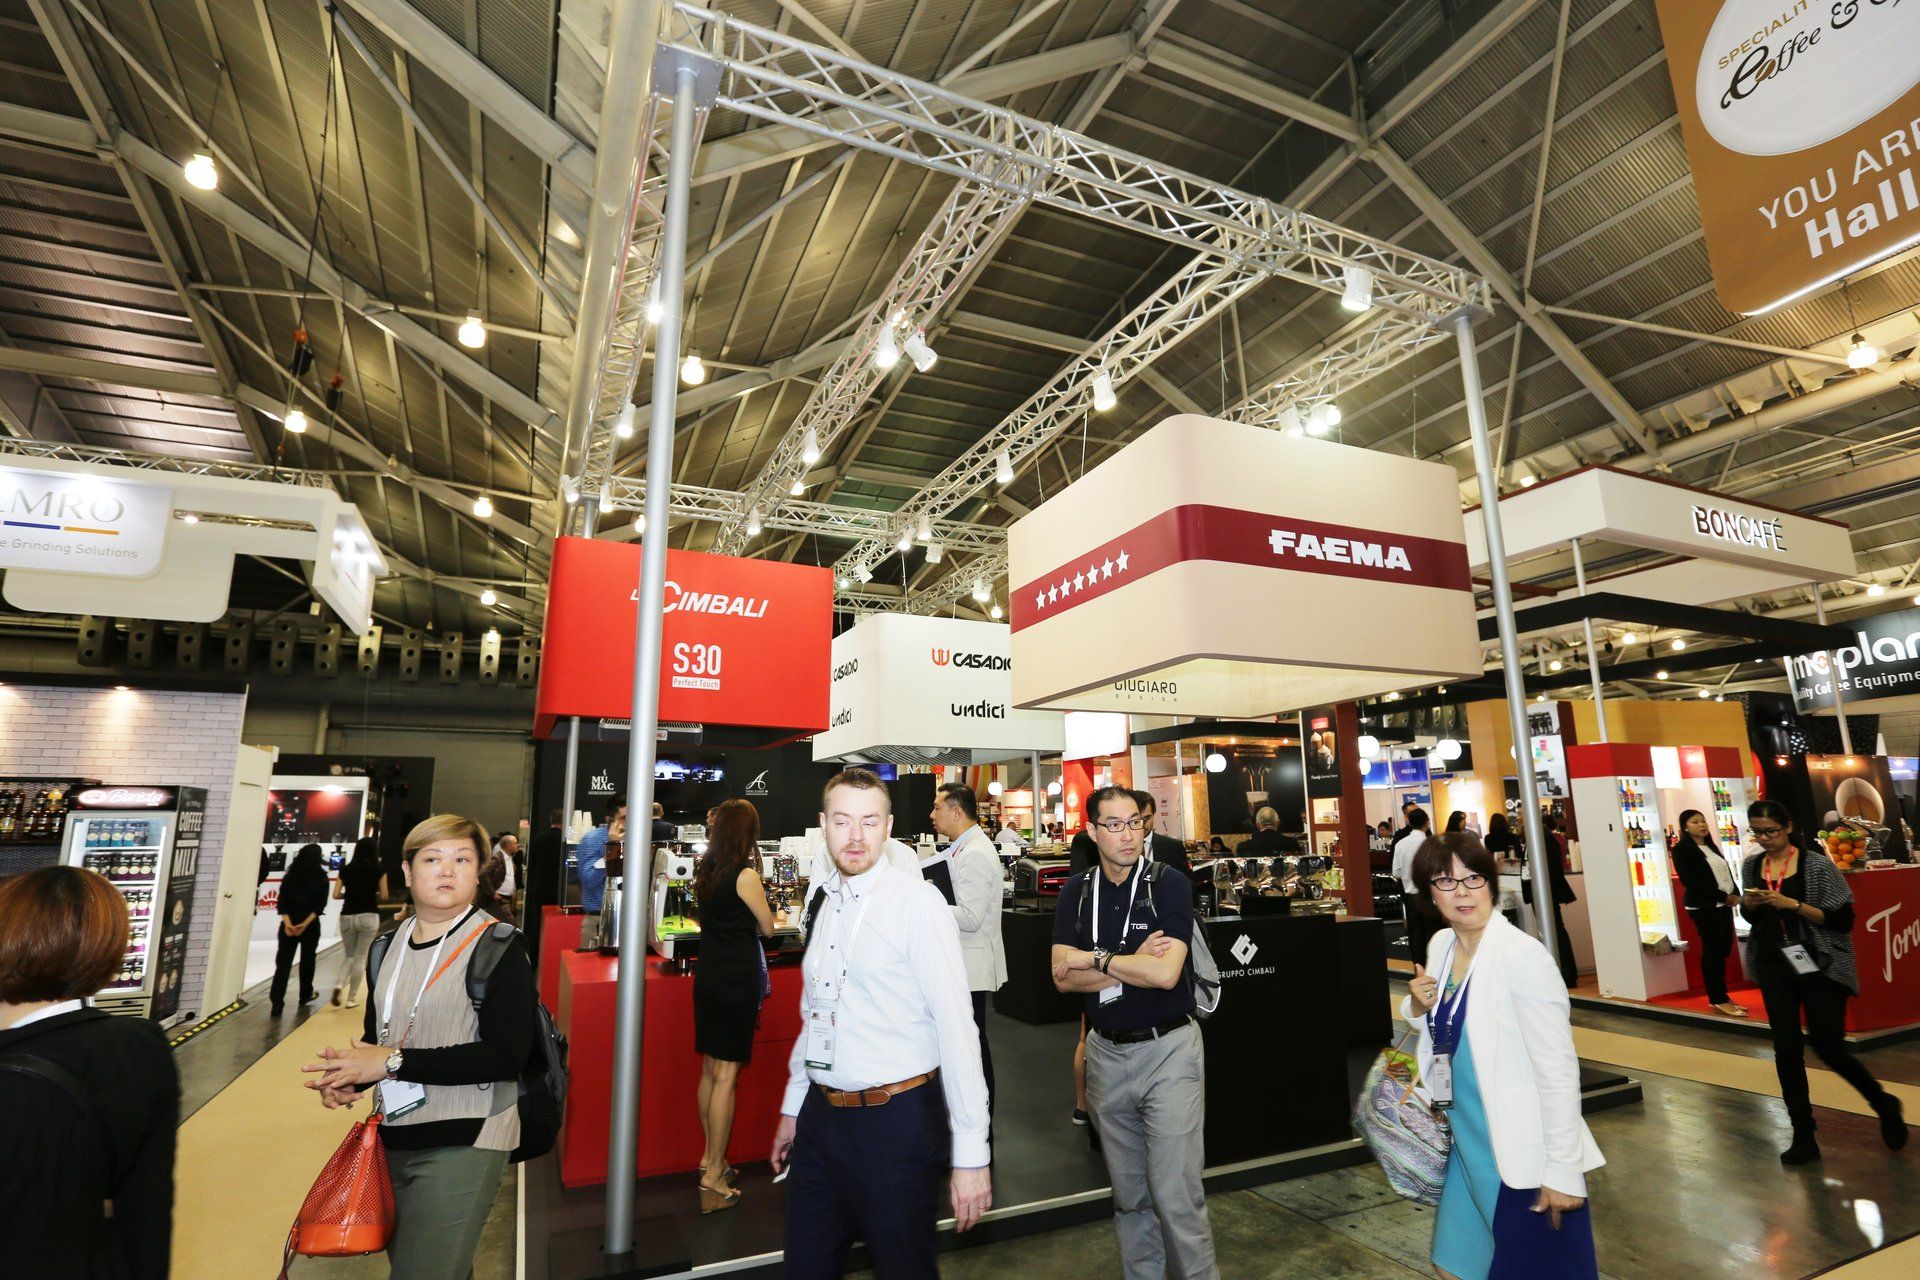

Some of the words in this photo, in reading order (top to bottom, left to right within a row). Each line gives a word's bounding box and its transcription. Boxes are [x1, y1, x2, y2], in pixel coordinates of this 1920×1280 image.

[1718, 0, 1819, 70] SPECIALIT
[1720, 27, 1821, 109] Coffee
[1831, 1, 1858, 30] &
[1758, 167, 1837, 230] YOU
[1803, 167, 1920, 259] Hall
[0, 488, 125, 523] MRO
[1691, 505, 1787, 552] BONCAFÉ
[12, 538, 71, 555] Grinding
[76, 544, 138, 559] Solutions
[1268, 529, 1412, 572] FAEMA
[672, 642, 722, 676] S30
[833, 658, 859, 682] CASADIO
[673, 678, 698, 687] Perfect
[699, 679, 718, 688] Touch
[1114, 680, 1177, 695] GIUGIARO
[1815, 680, 1851, 696] Cofee
[832, 708, 852, 728] undici
[951, 699, 1005, 719] undici
[591, 775, 608, 783] MU
[591, 782, 614, 791] MAC
[178, 811, 203, 832] COFFEE
[172, 848, 198, 877] MILK
[1217, 969, 1245, 979] GRUPPO
[1247, 966, 1276, 976] CIMBALI
